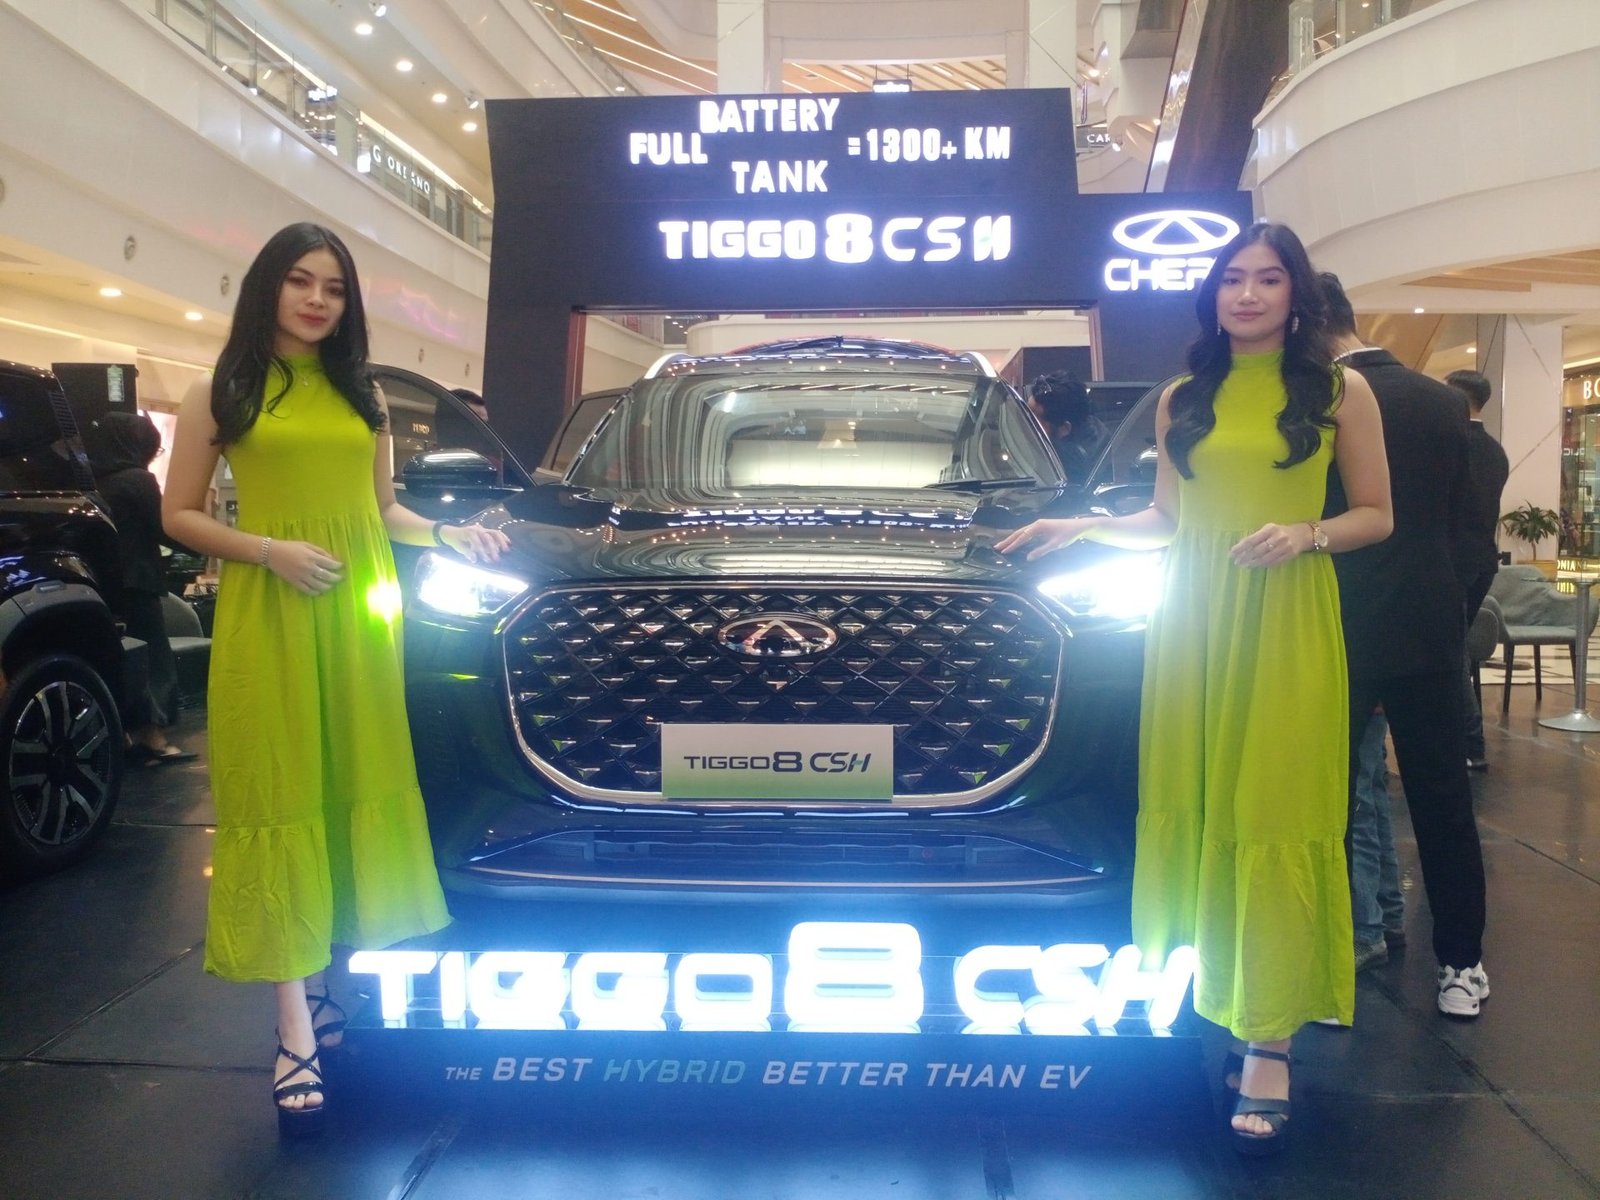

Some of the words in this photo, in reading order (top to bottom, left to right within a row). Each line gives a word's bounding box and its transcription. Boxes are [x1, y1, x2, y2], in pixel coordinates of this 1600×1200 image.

[699, 99, 840, 133] BATTERY
[630, 132, 708, 165] FULL
[965, 126, 1011, 160] KM
[731, 160, 829, 194] TANK
[1104, 256, 1217, 291] CHER
[809, 752, 872, 773] CSH
[953, 943, 1199, 1029] CSH
[445, 1066, 483, 1082] THE
[492, 1056, 594, 1083] BEST
[604, 1058, 747, 1085] HYBRID
[762, 1060, 909, 1087] BETTER
[926, 1062, 1028, 1089] THAN
[1039, 1065, 1092, 1090] EV
